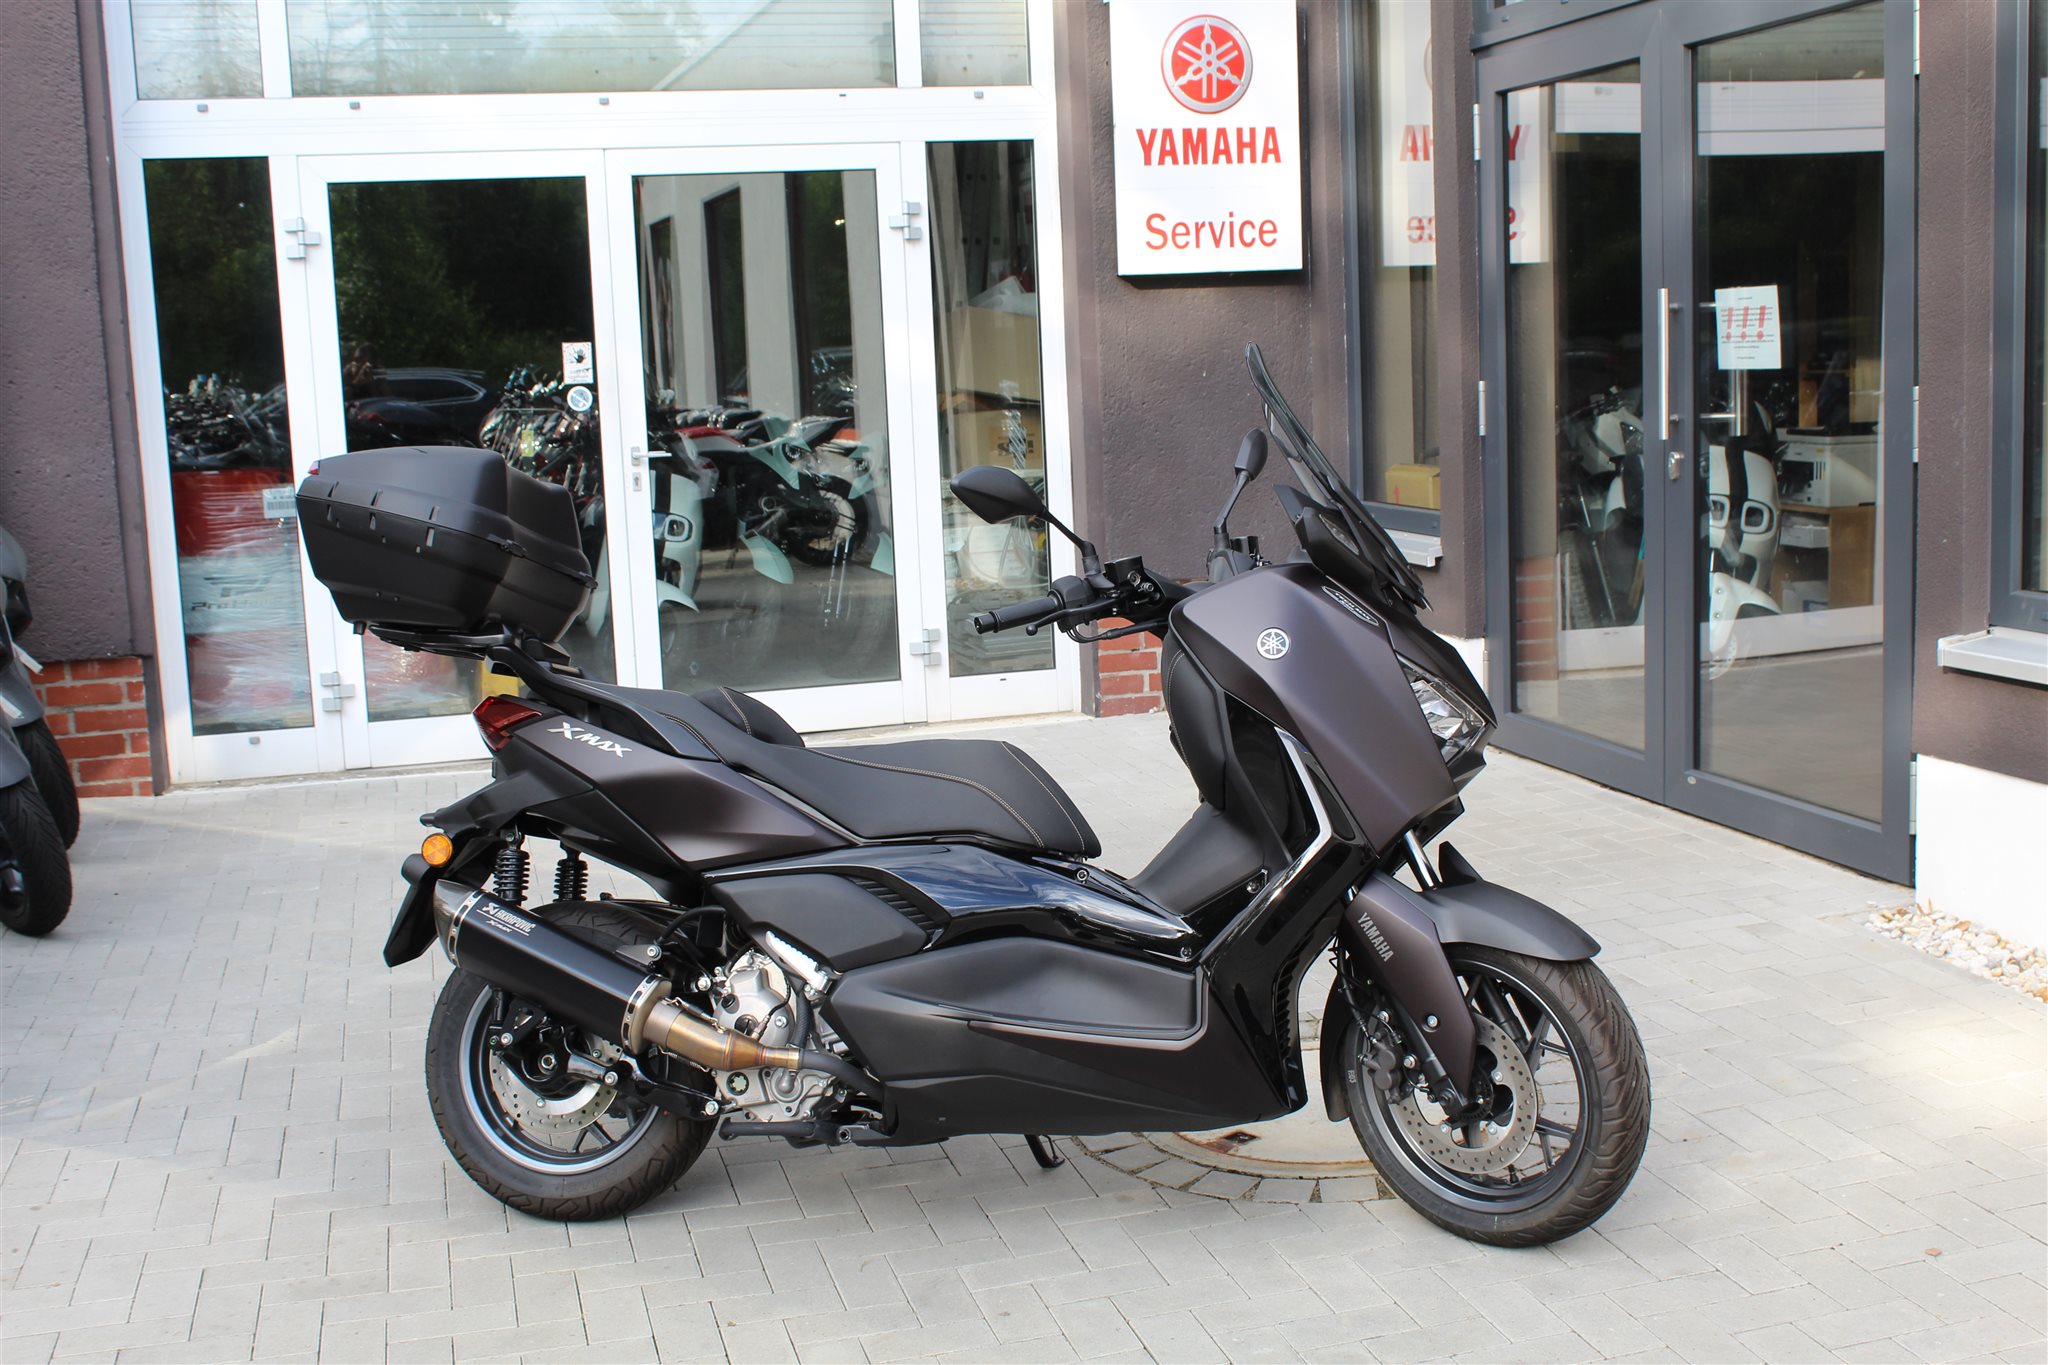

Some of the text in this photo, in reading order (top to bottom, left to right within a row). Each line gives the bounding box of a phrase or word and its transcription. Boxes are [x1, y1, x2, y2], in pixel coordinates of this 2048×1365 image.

[1136, 127, 1281, 166] YAMAHA
[1145, 211, 1278, 250] Service
[1357, 912, 1394, 962] YAMAHA
